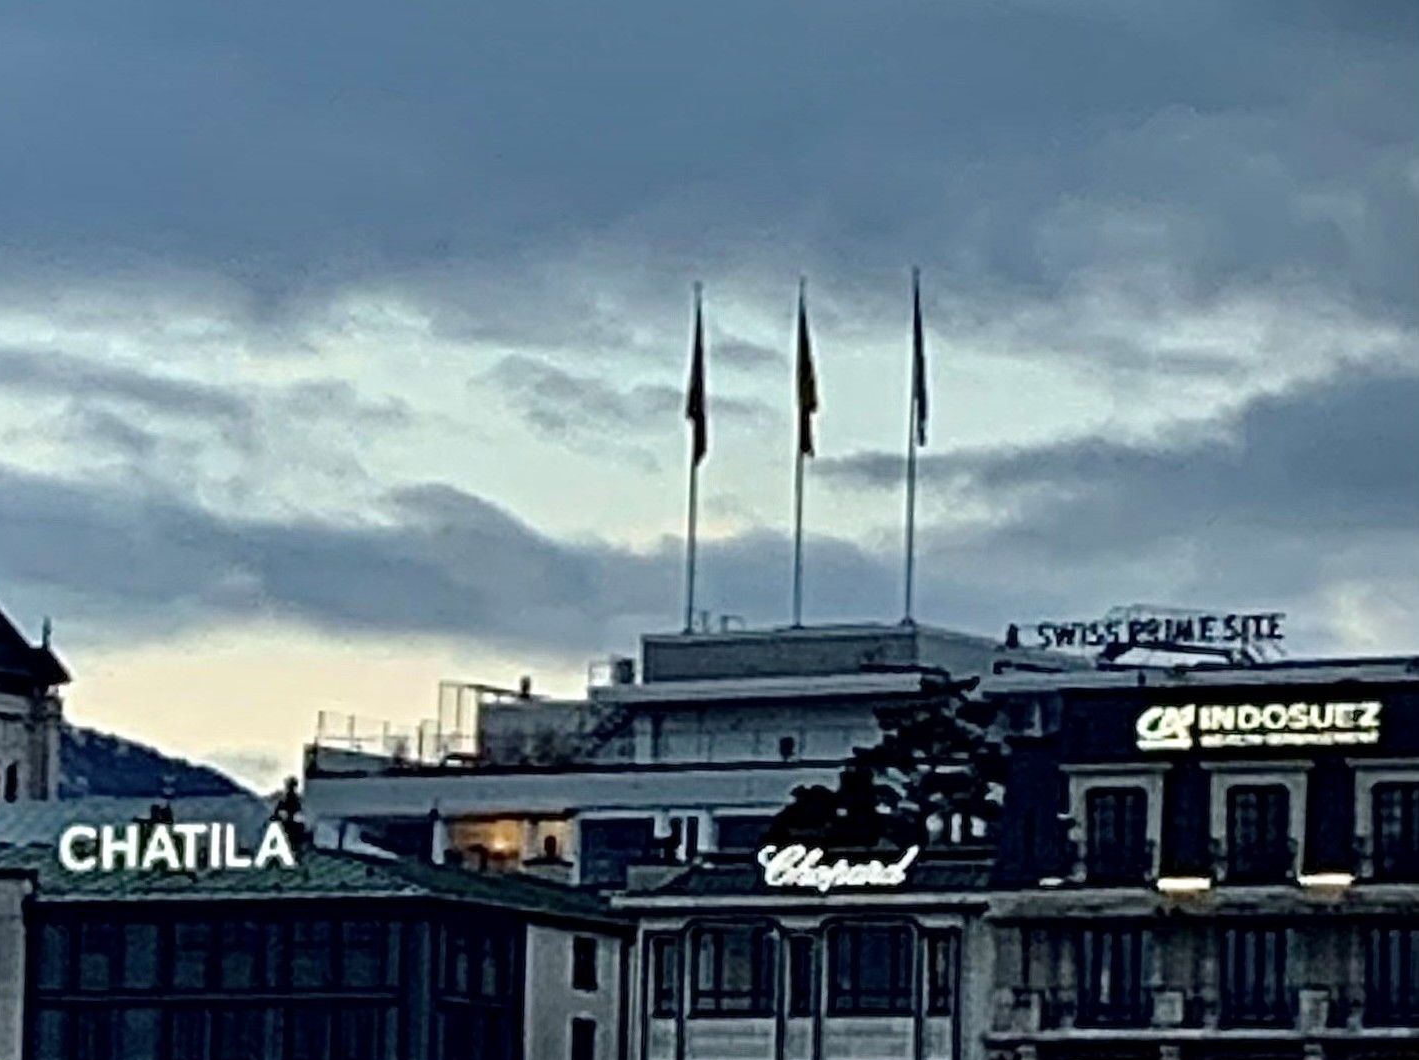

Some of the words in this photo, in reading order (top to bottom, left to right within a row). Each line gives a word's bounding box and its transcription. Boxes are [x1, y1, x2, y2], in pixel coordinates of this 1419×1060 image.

[1037, 621, 1123, 647] SWISS
[1222, 613, 1287, 642] SITE
[1198, 701, 1383, 732] INDOSUEZ
[57, 822, 296, 872] CHATILA
